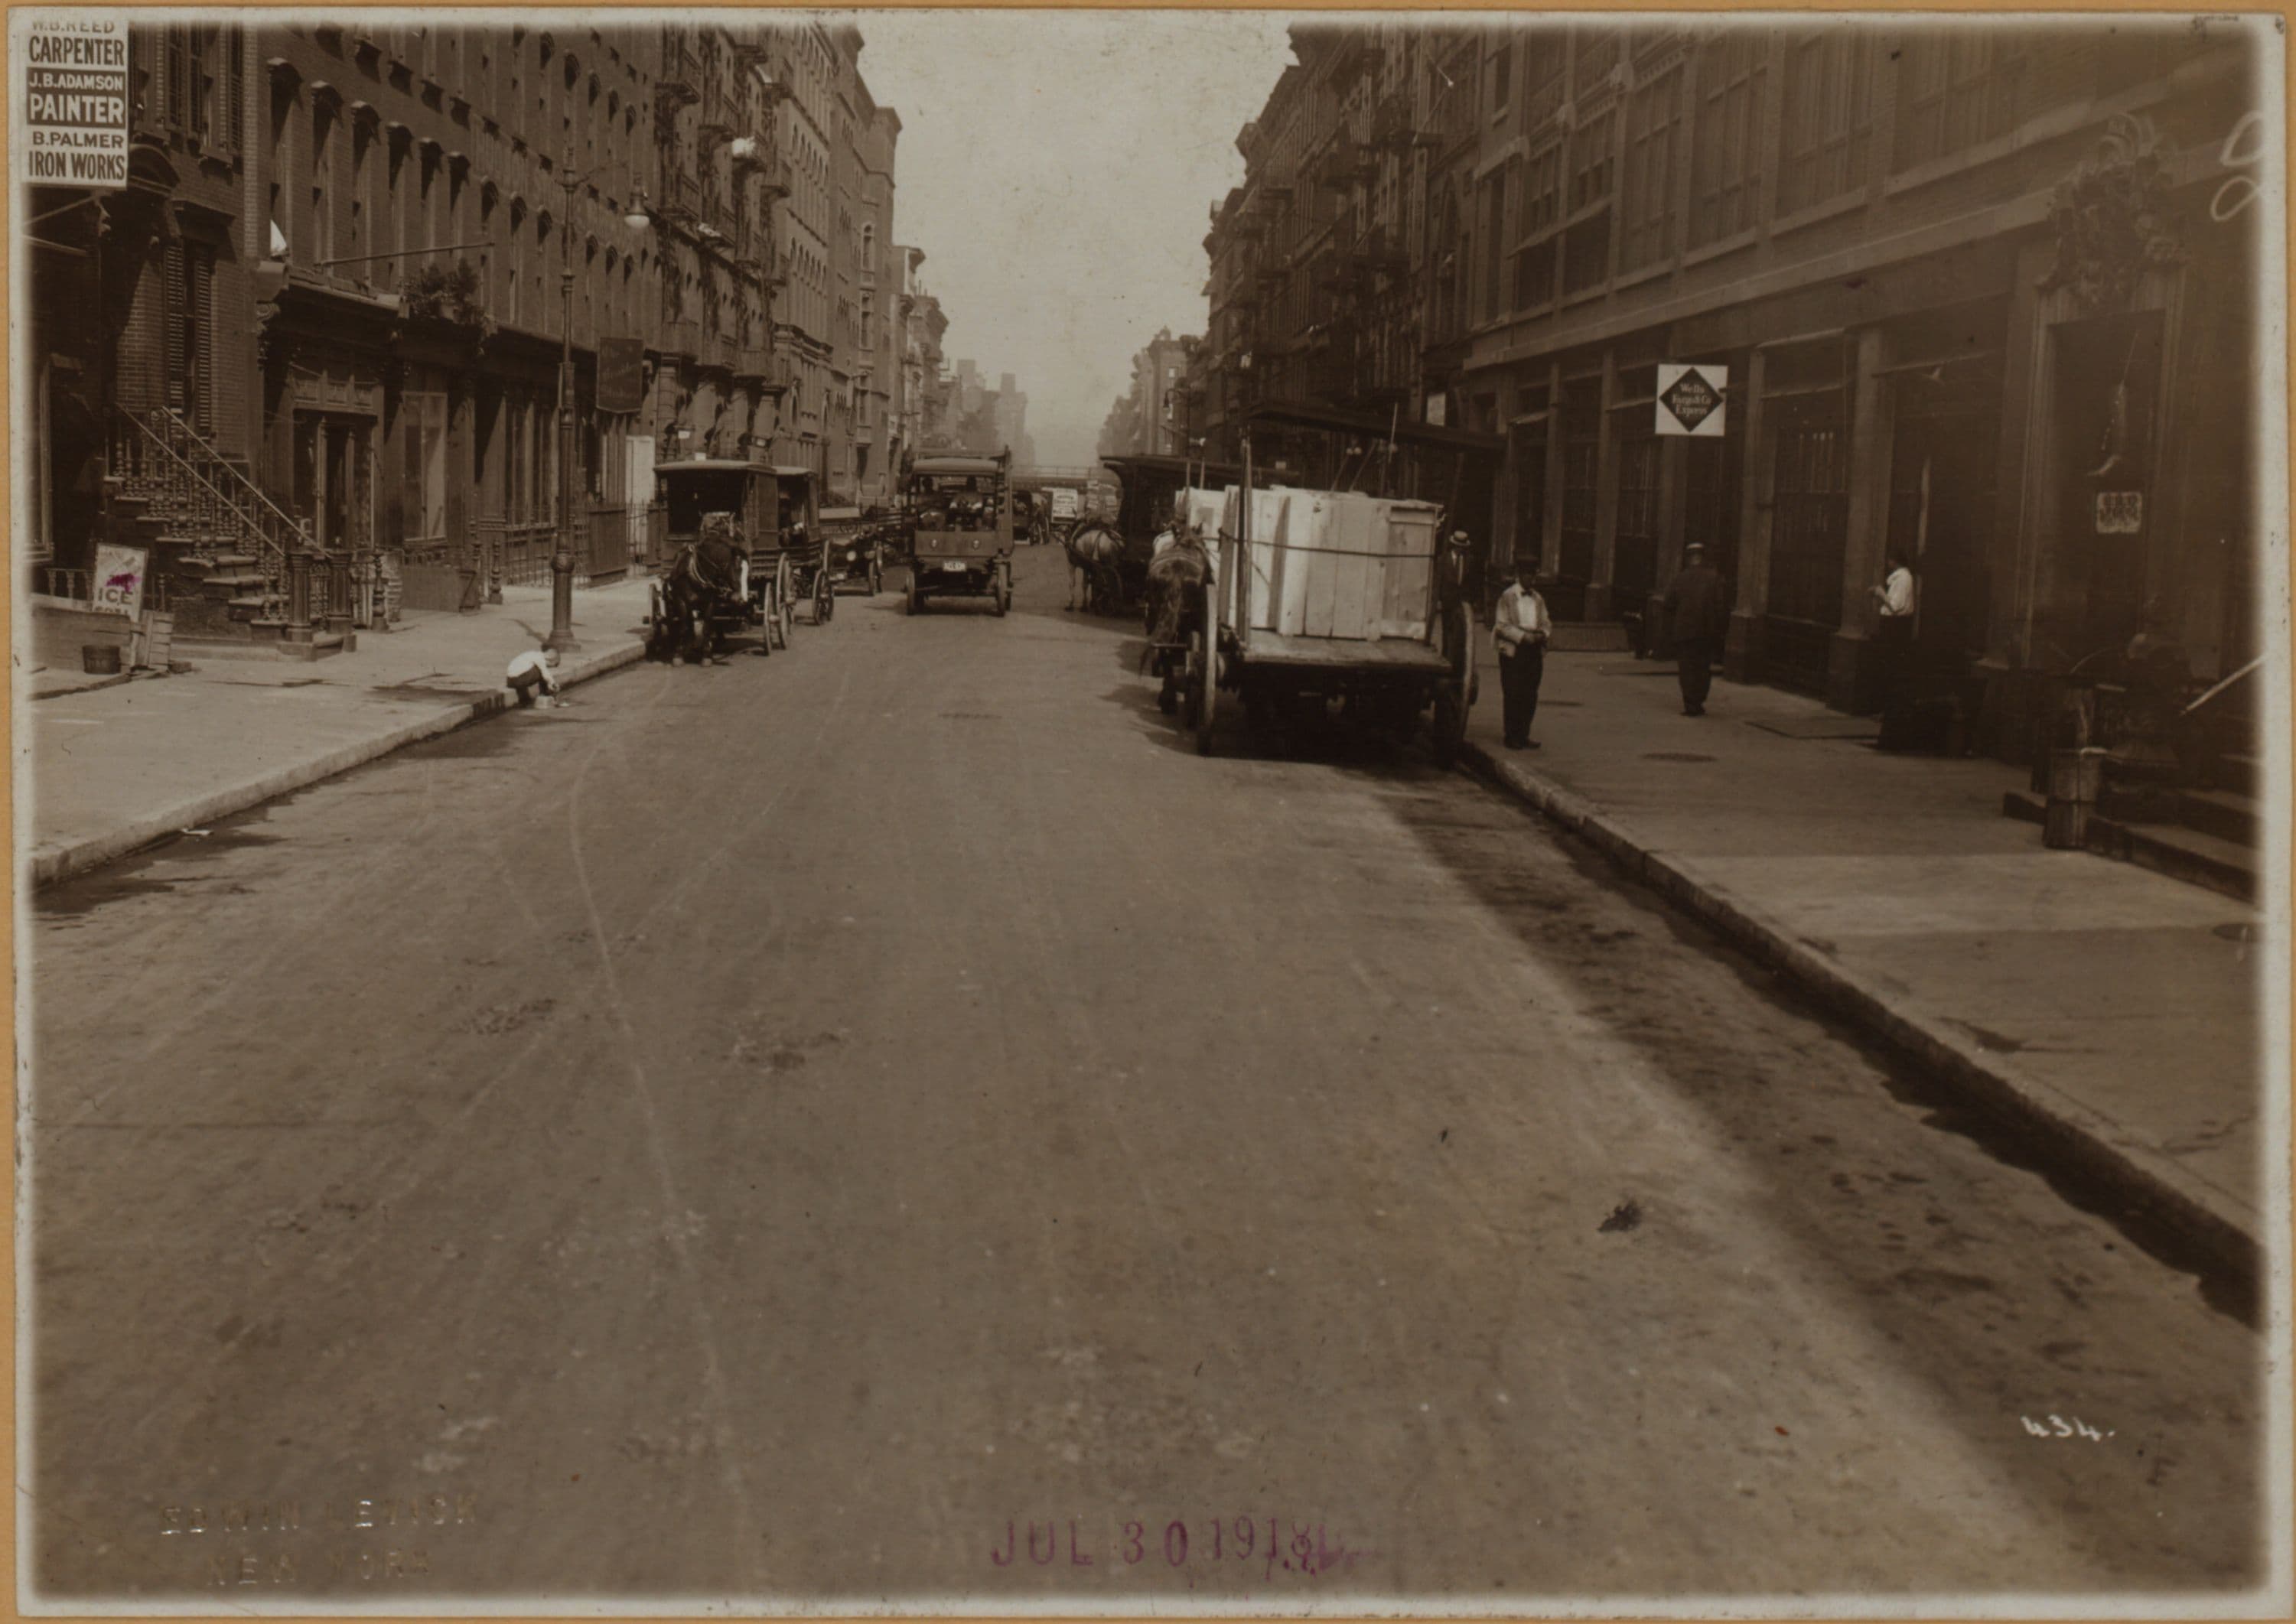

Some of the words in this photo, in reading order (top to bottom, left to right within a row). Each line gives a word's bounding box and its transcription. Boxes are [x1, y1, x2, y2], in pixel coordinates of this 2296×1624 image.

[29, 35, 124, 66] CARPENTER
[31, 93, 124, 123] PAINTER
[28, 151, 67, 177] IRON
[70, 152, 125, 180] WORKS
[98, 588, 134, 604] ICE
